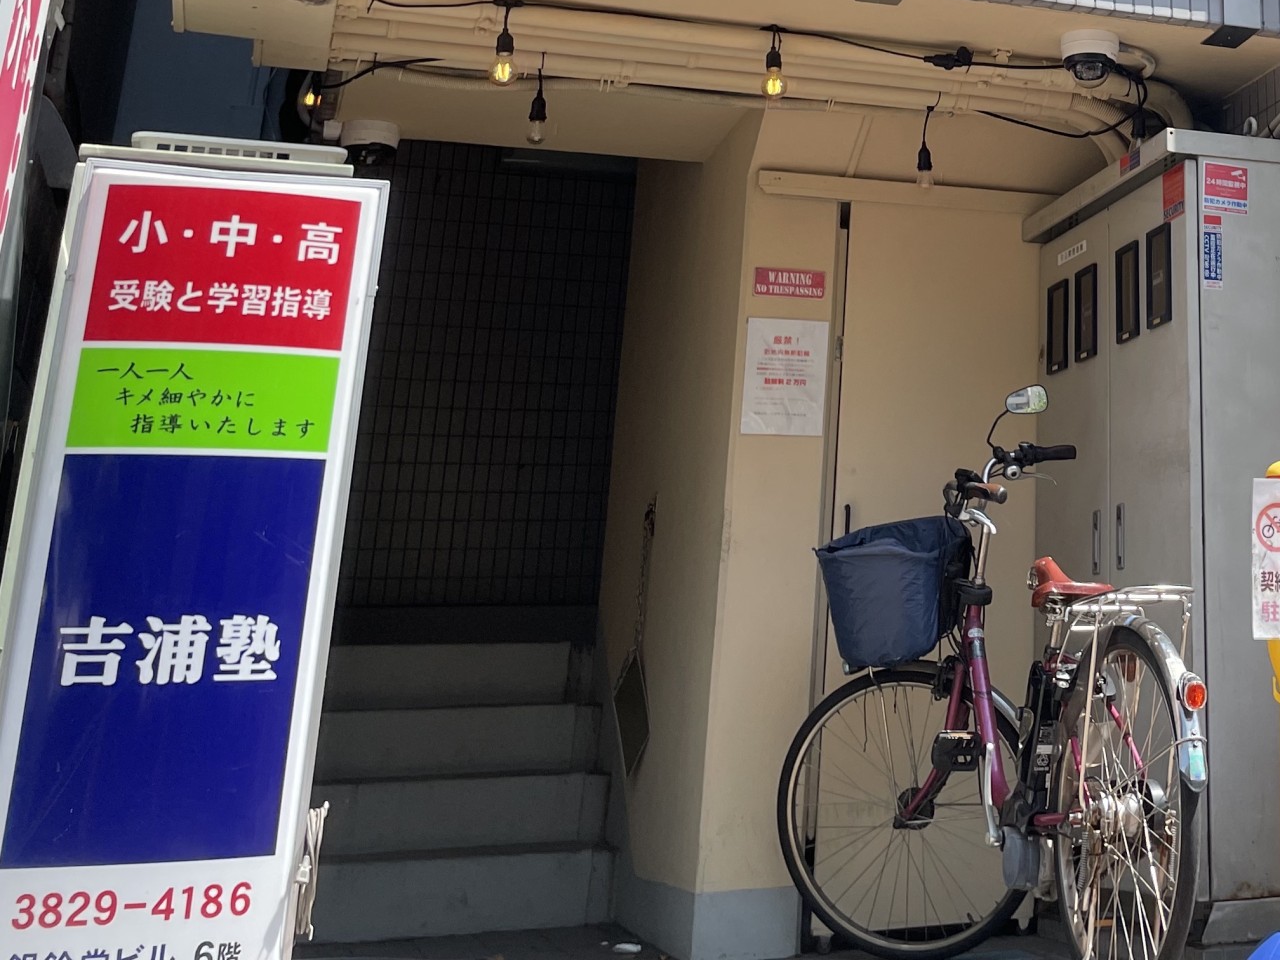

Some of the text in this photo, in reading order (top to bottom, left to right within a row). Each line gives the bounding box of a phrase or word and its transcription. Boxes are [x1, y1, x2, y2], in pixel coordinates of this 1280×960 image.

[118, 210, 344, 265] 小・中・高
[755, 284, 823, 297] NO TRESPASSING
[768, 271, 813, 286] WARNING
[107, 279, 333, 321] 受験と学習指導
[96, 362, 195, 381] 一人一人
[115, 386, 256, 408] キメ細やかに
[130, 413, 317, 439] 指導いたします
[60, 614, 281, 686] 吉浦塾
[11, 881, 253, 931] 3829-4186
